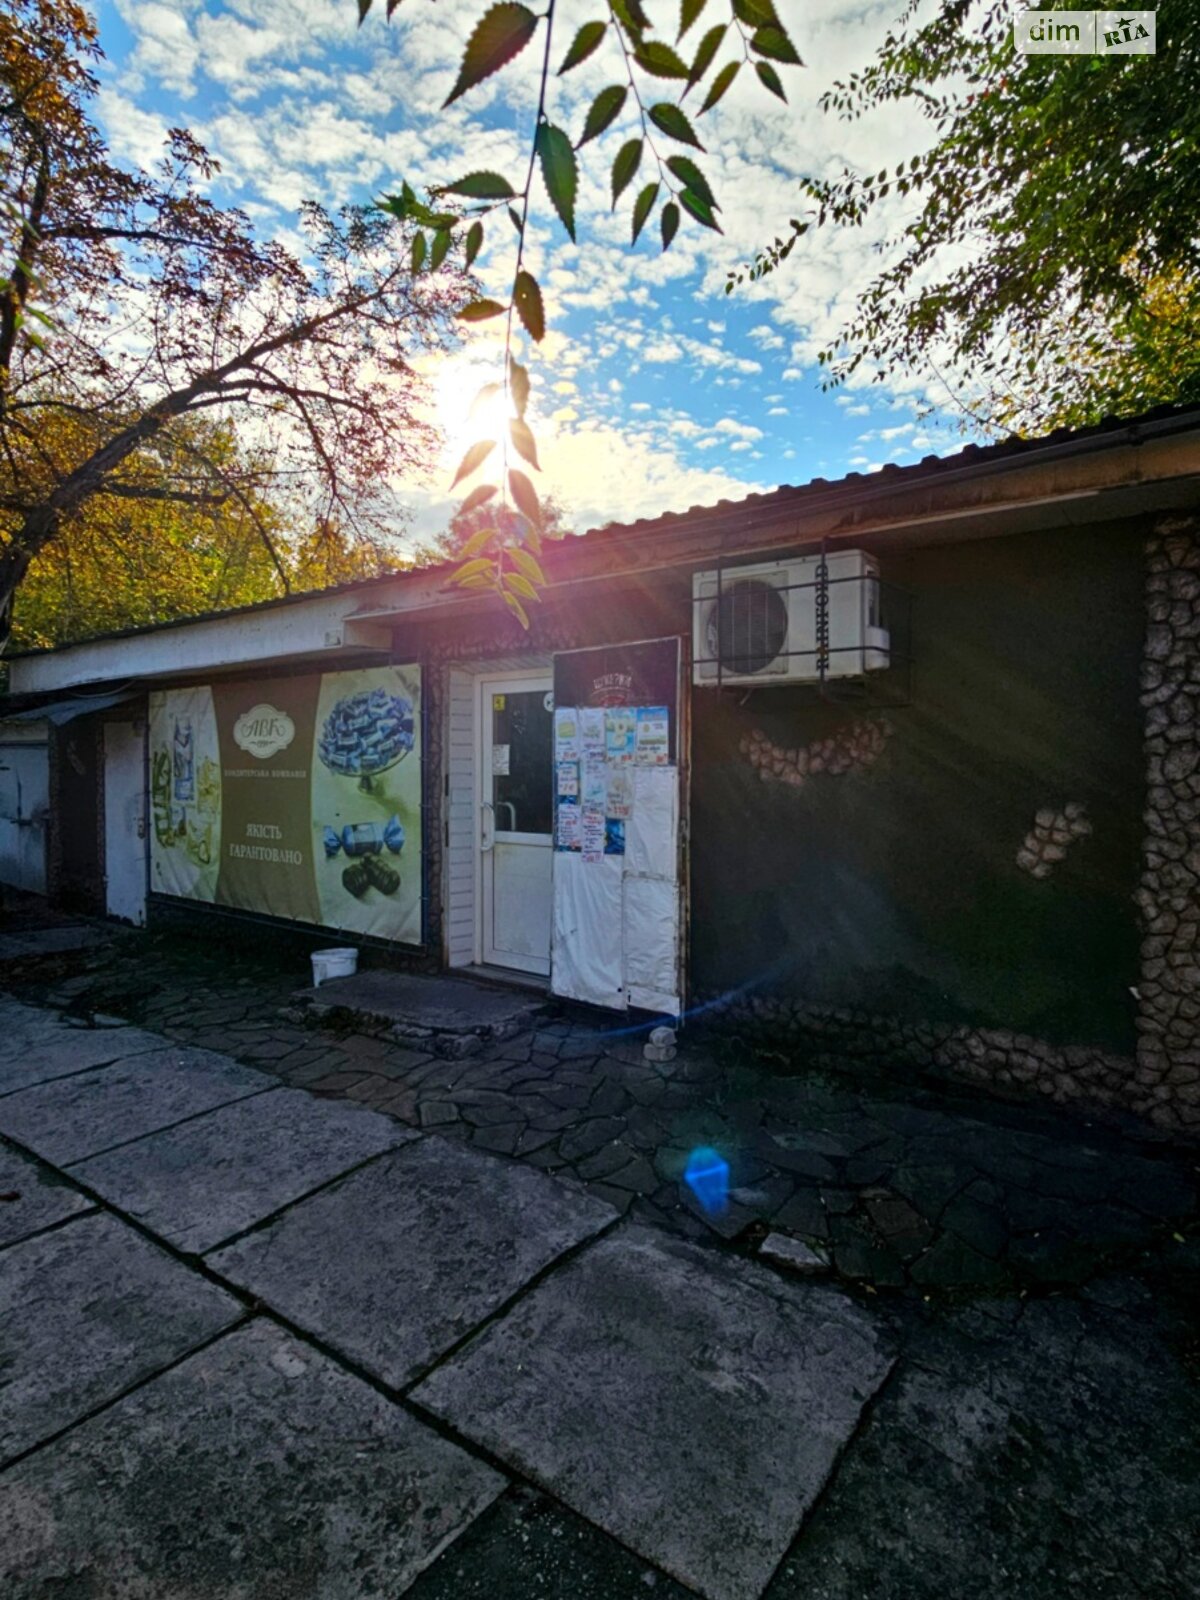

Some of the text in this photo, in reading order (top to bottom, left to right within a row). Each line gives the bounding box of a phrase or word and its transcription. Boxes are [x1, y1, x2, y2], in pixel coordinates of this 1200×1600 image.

[241, 718, 285, 737] АВК
[246, 823, 282, 840] ЯКІСТЬ
[230, 843, 302, 864] ГАРАНТОВАНО
